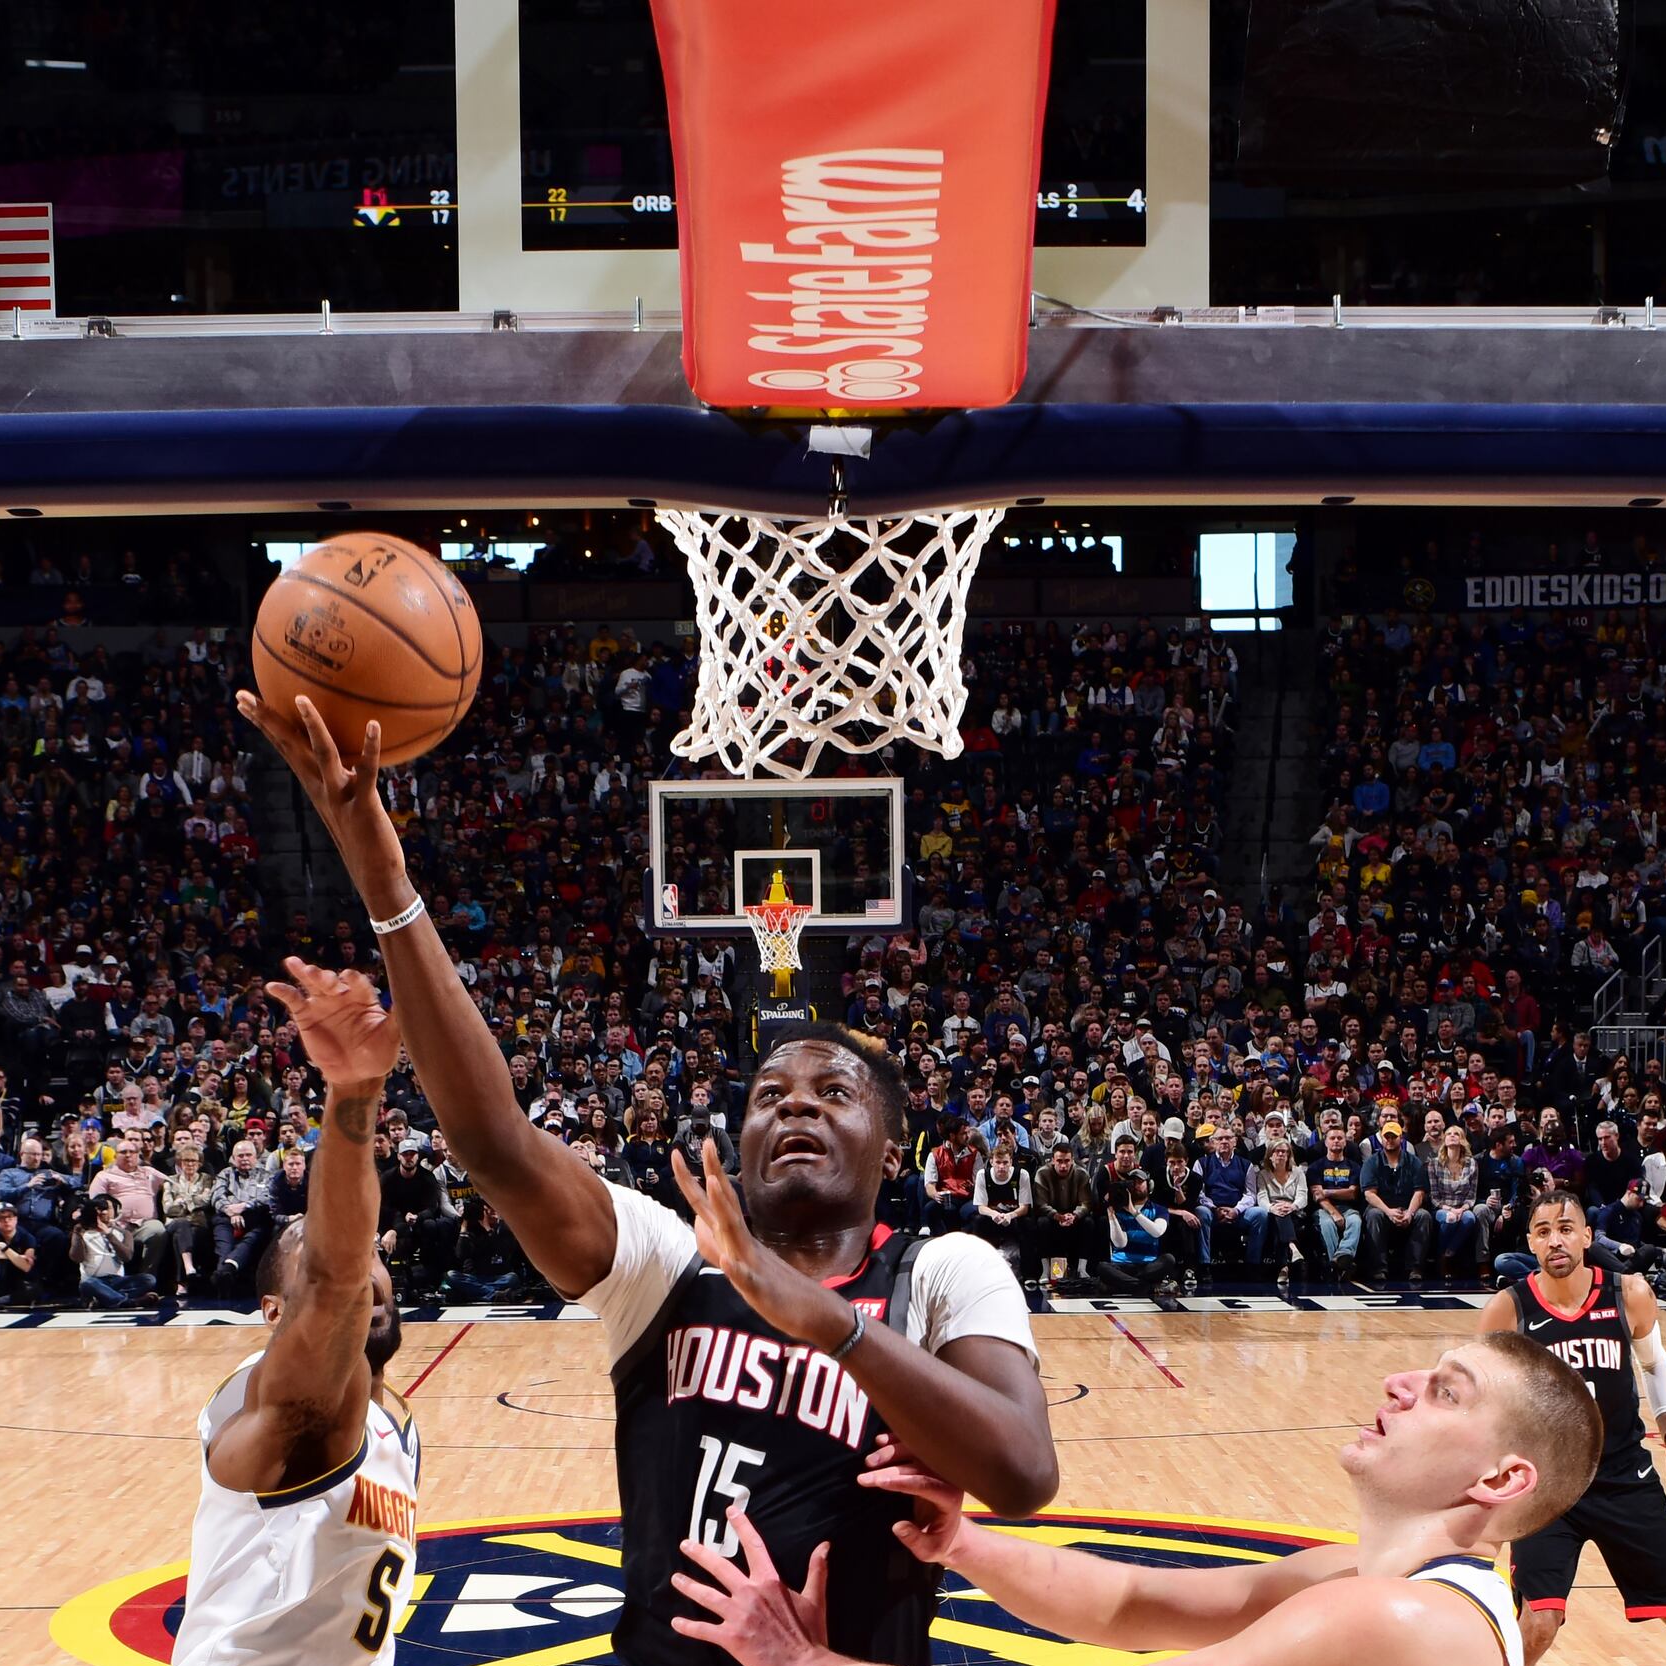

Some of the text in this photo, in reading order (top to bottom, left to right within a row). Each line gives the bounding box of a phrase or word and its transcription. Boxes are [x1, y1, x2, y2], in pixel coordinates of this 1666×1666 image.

[430, 190, 450, 205] 22
[547, 188, 568, 203] 22
[1067, 183, 1078, 198] 2
[432, 210, 450, 224] 17
[550, 208, 567, 222] 17
[1067, 203, 1078, 218] 2
[1546, 1337, 1621, 1371] USTON
[667, 1325, 872, 1451] HOUSTON
[683, 1433, 768, 1559] 15
